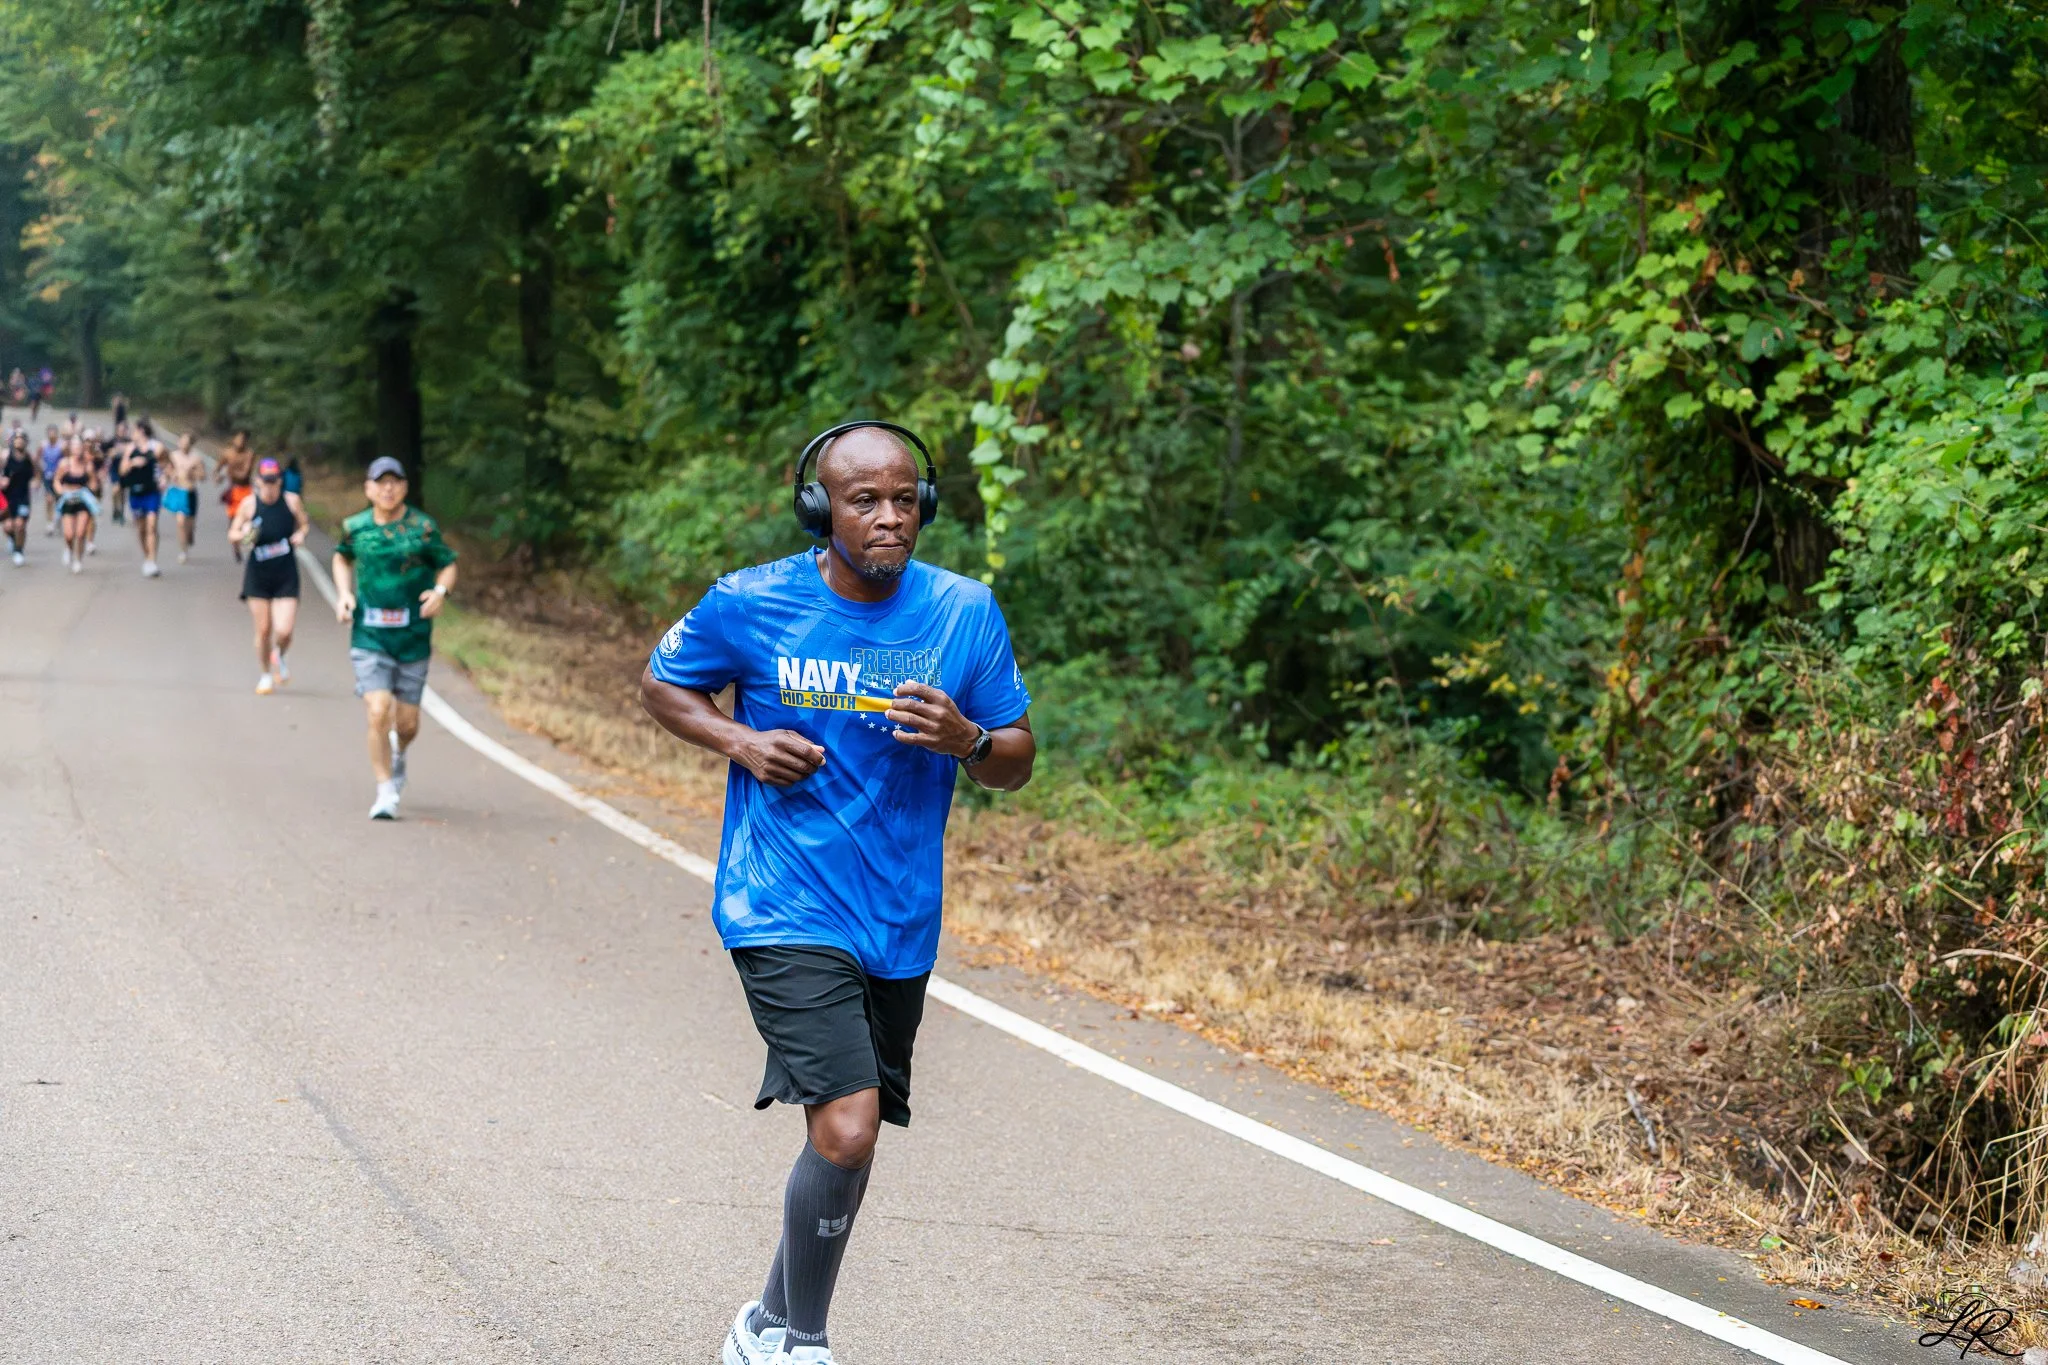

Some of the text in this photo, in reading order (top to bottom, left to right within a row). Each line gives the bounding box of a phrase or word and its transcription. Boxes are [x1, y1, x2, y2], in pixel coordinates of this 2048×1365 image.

[851, 647, 942, 675] FREEDOM
[777, 656, 862, 695] NAVY
[782, 690, 857, 710] MID-SOUTH
